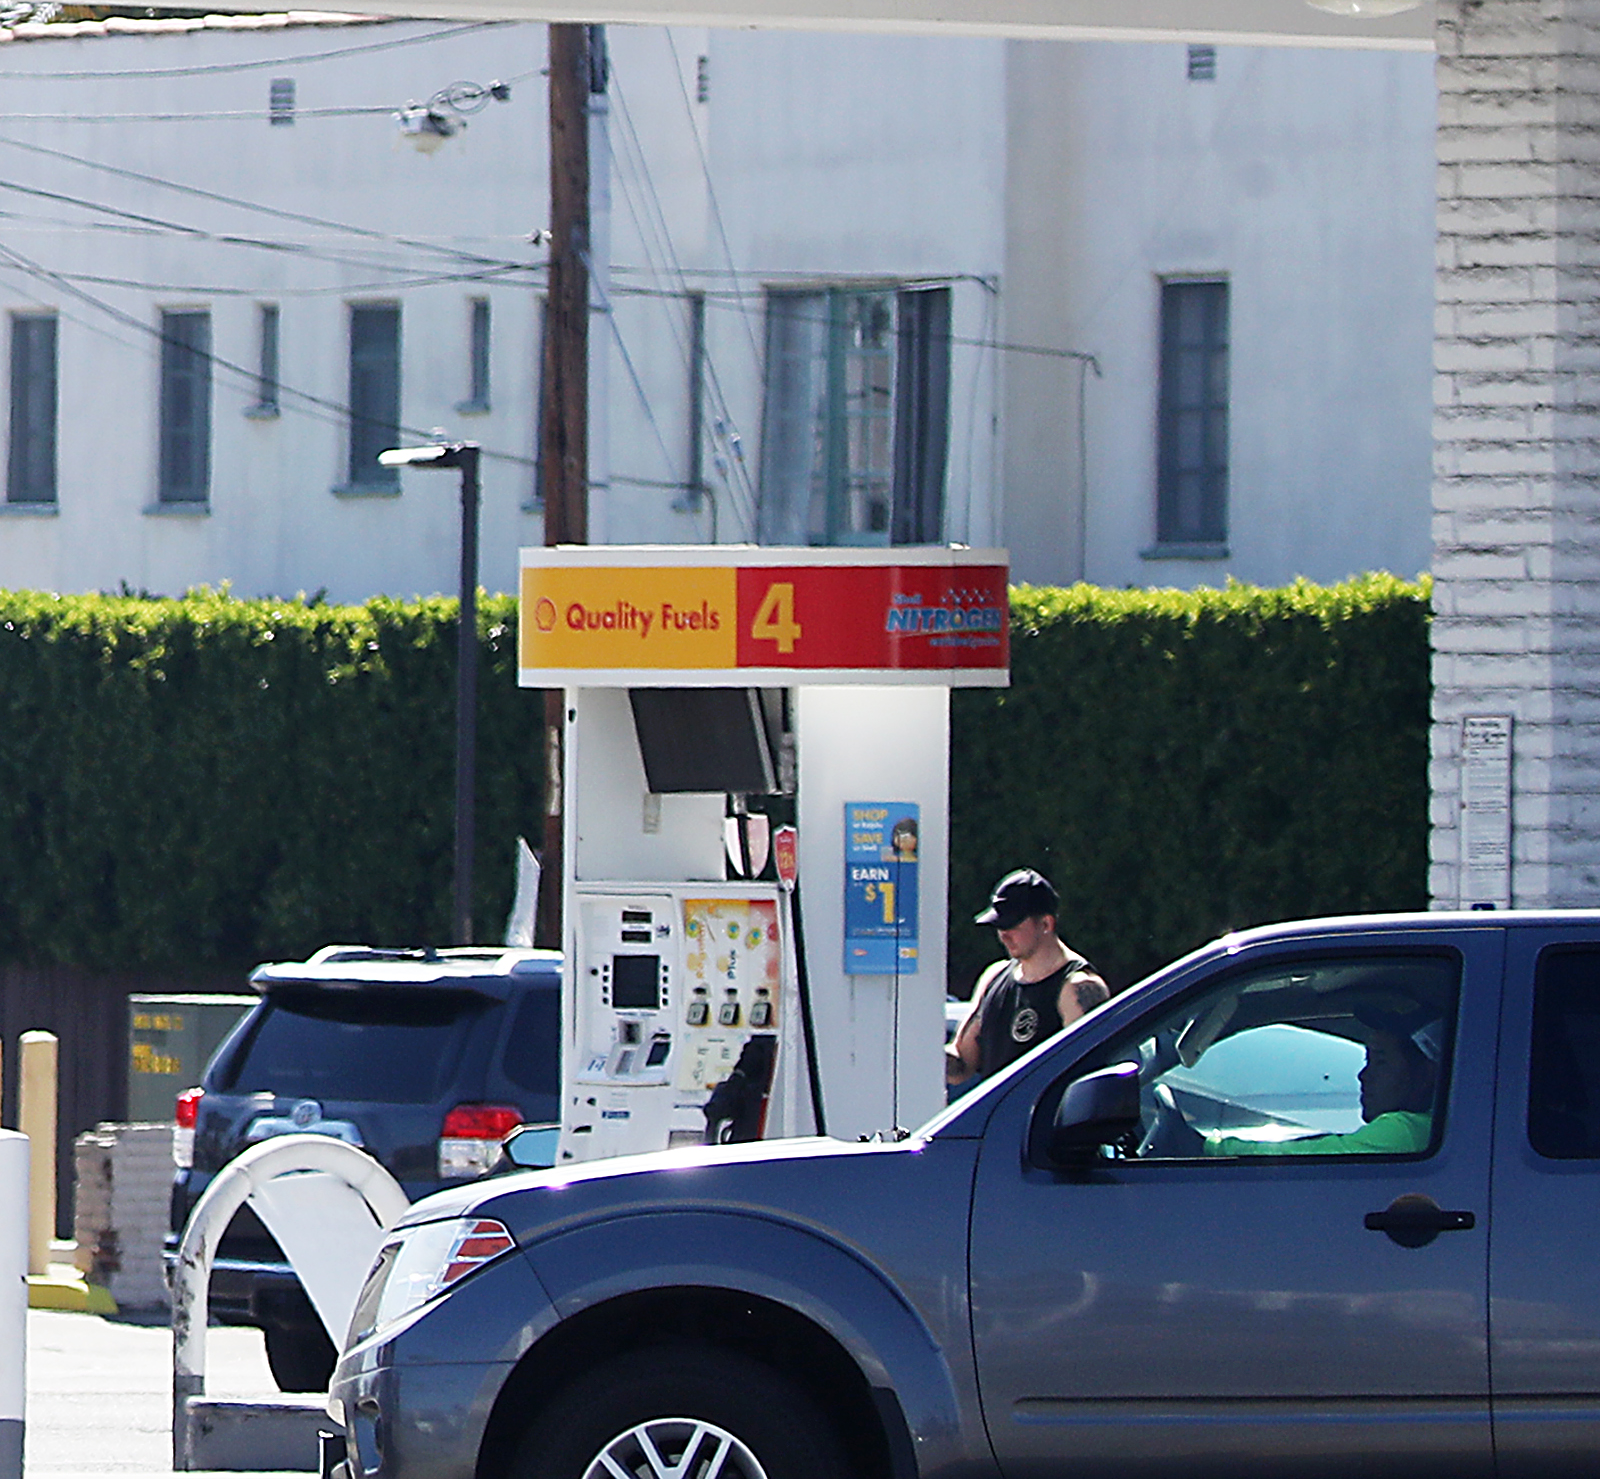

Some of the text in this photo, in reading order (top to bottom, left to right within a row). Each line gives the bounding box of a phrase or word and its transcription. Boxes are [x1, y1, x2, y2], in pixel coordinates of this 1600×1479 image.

[566, 582, 801, 654] Quality Fuels 4
[852, 868, 889, 881] EARN
